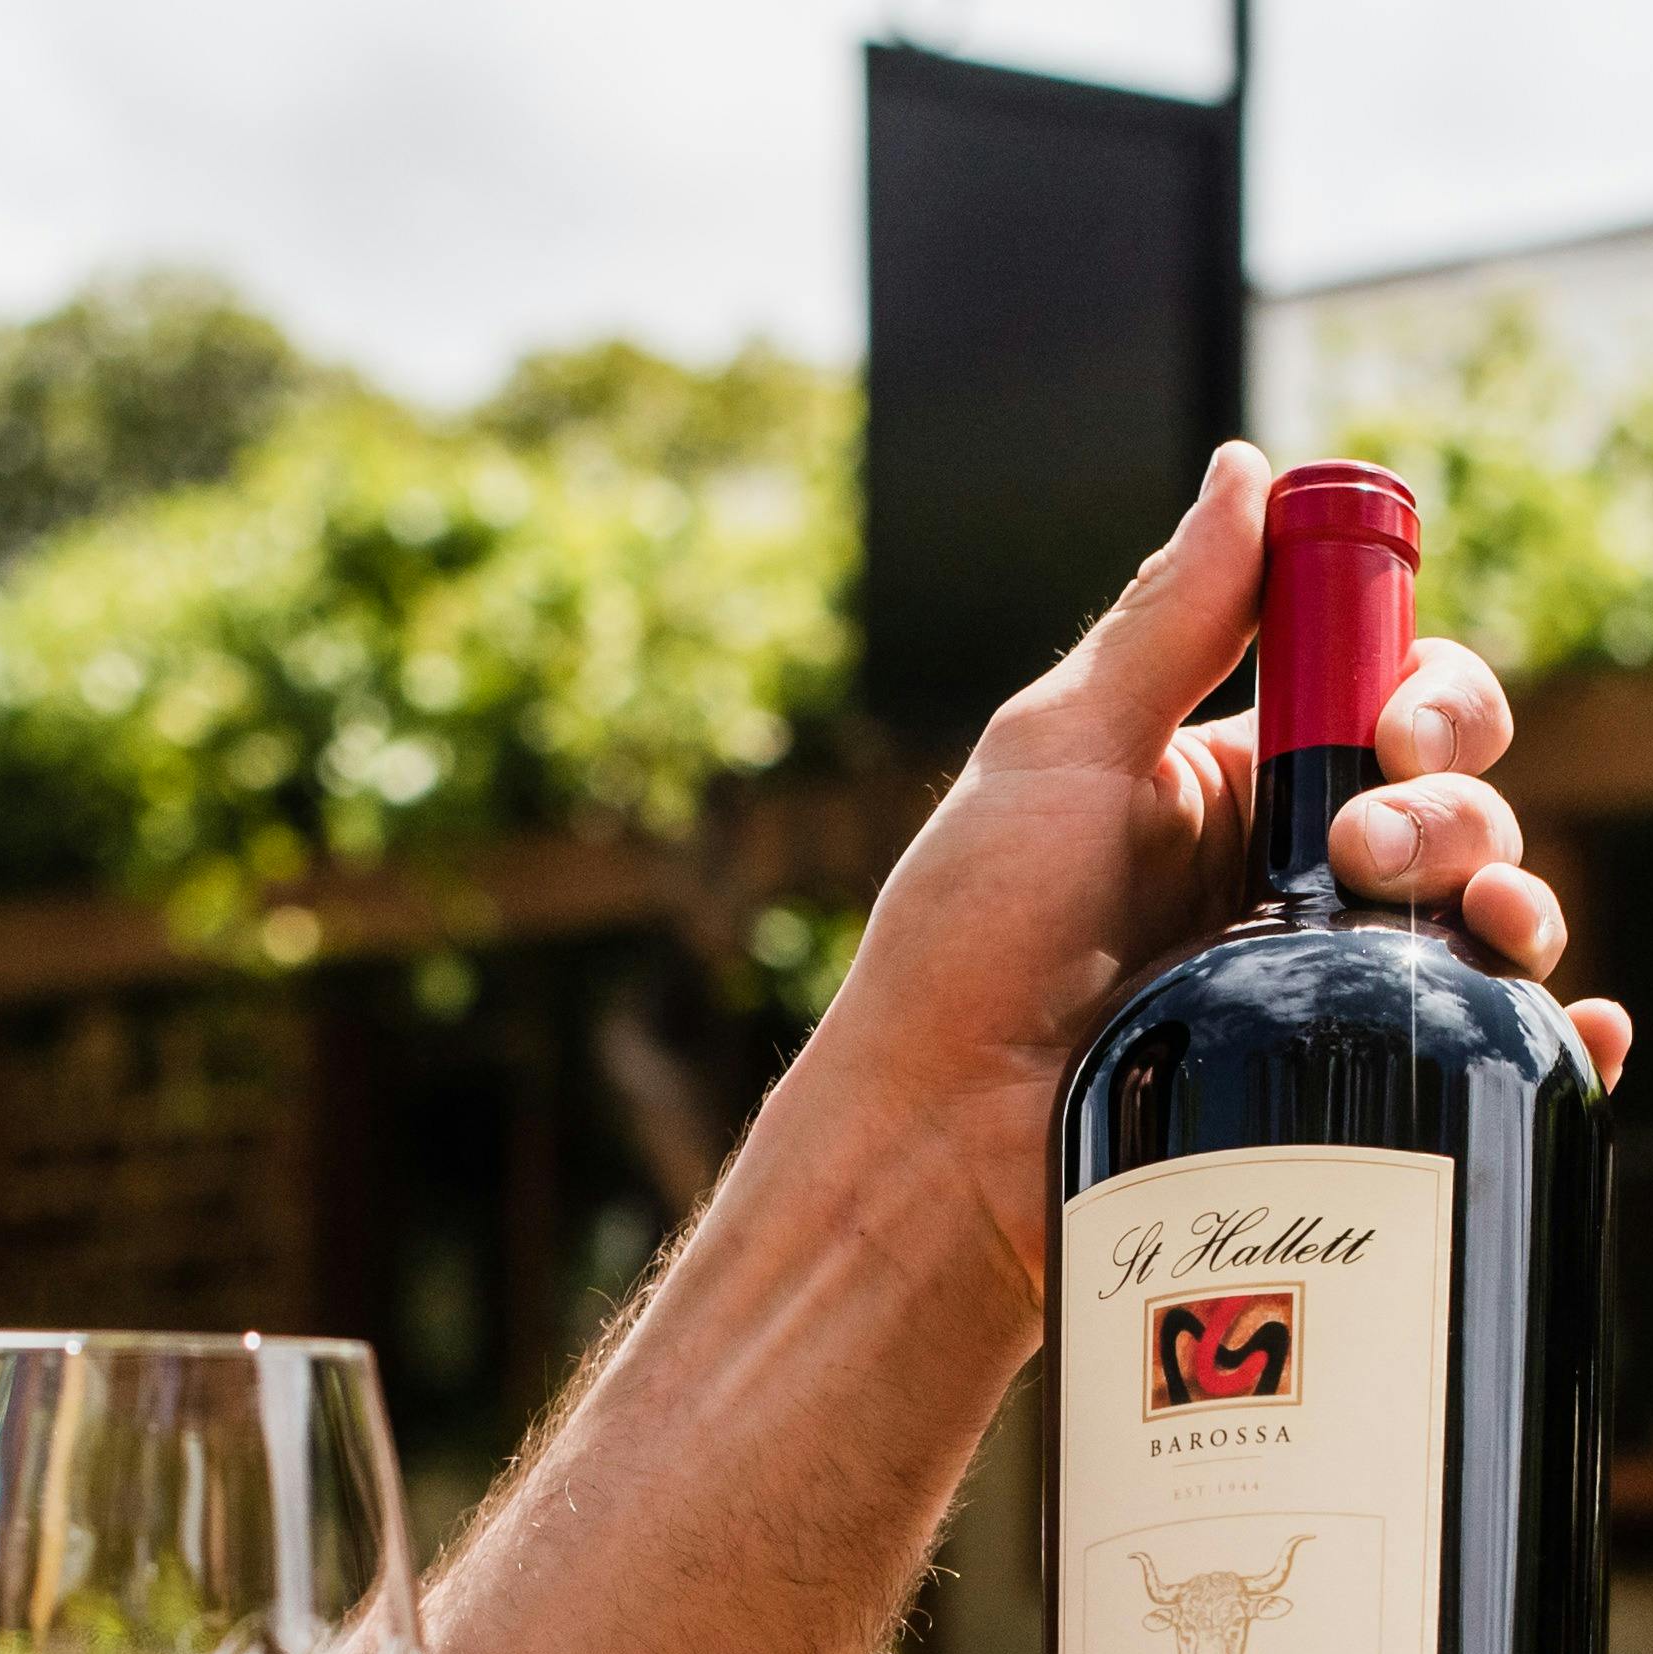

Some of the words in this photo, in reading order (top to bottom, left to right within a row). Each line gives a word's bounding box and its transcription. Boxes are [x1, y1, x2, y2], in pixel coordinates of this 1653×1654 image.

[1099, 1220, 1164, 1301] St
[1171, 1206, 1377, 1279] Hallett
[1149, 1425, 1292, 1458] BAROSSA
